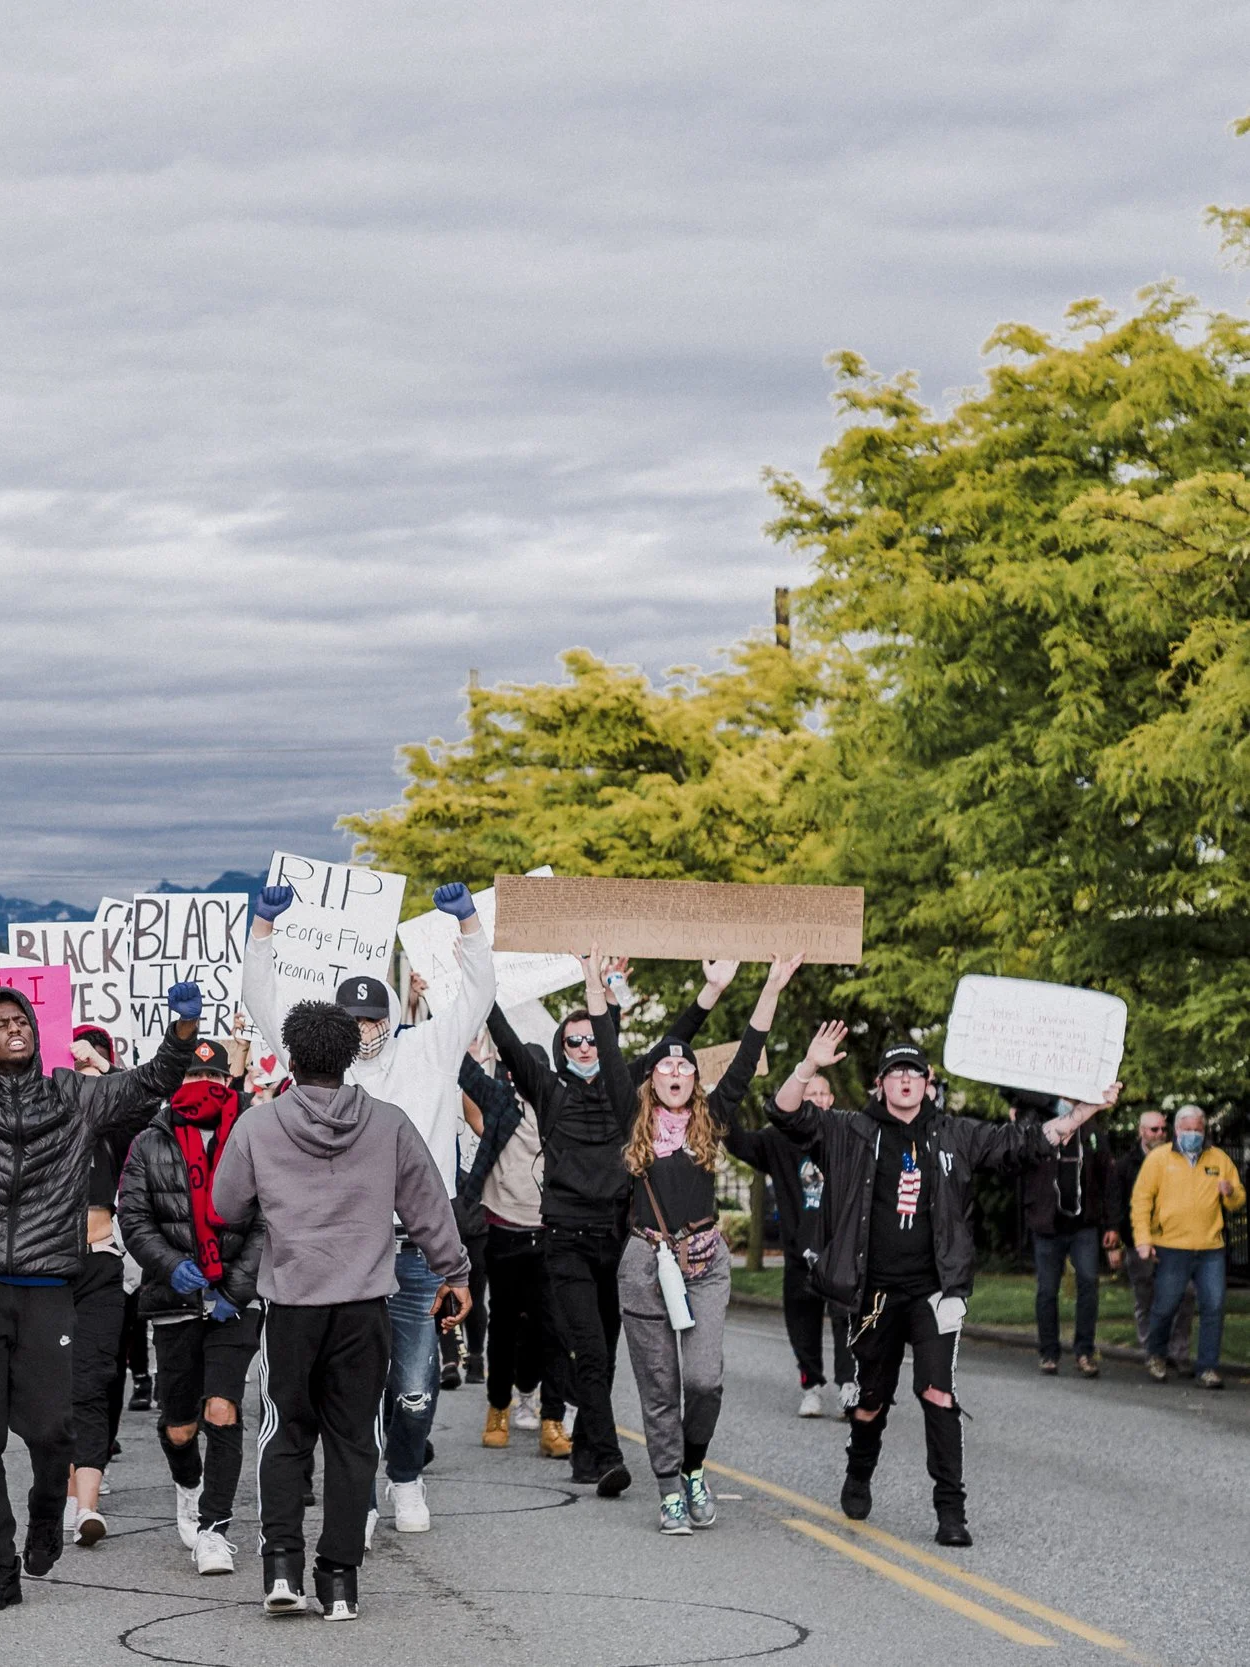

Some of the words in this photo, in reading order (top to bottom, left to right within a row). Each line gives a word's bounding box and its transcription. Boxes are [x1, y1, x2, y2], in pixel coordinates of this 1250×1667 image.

[16, 927, 125, 974] BLACK
[133, 898, 248, 964] BLACK
[337, 928, 388, 961] Floyd
[130, 963, 233, 1002] LIVES
[130, 1000, 238, 1037] MATER!
